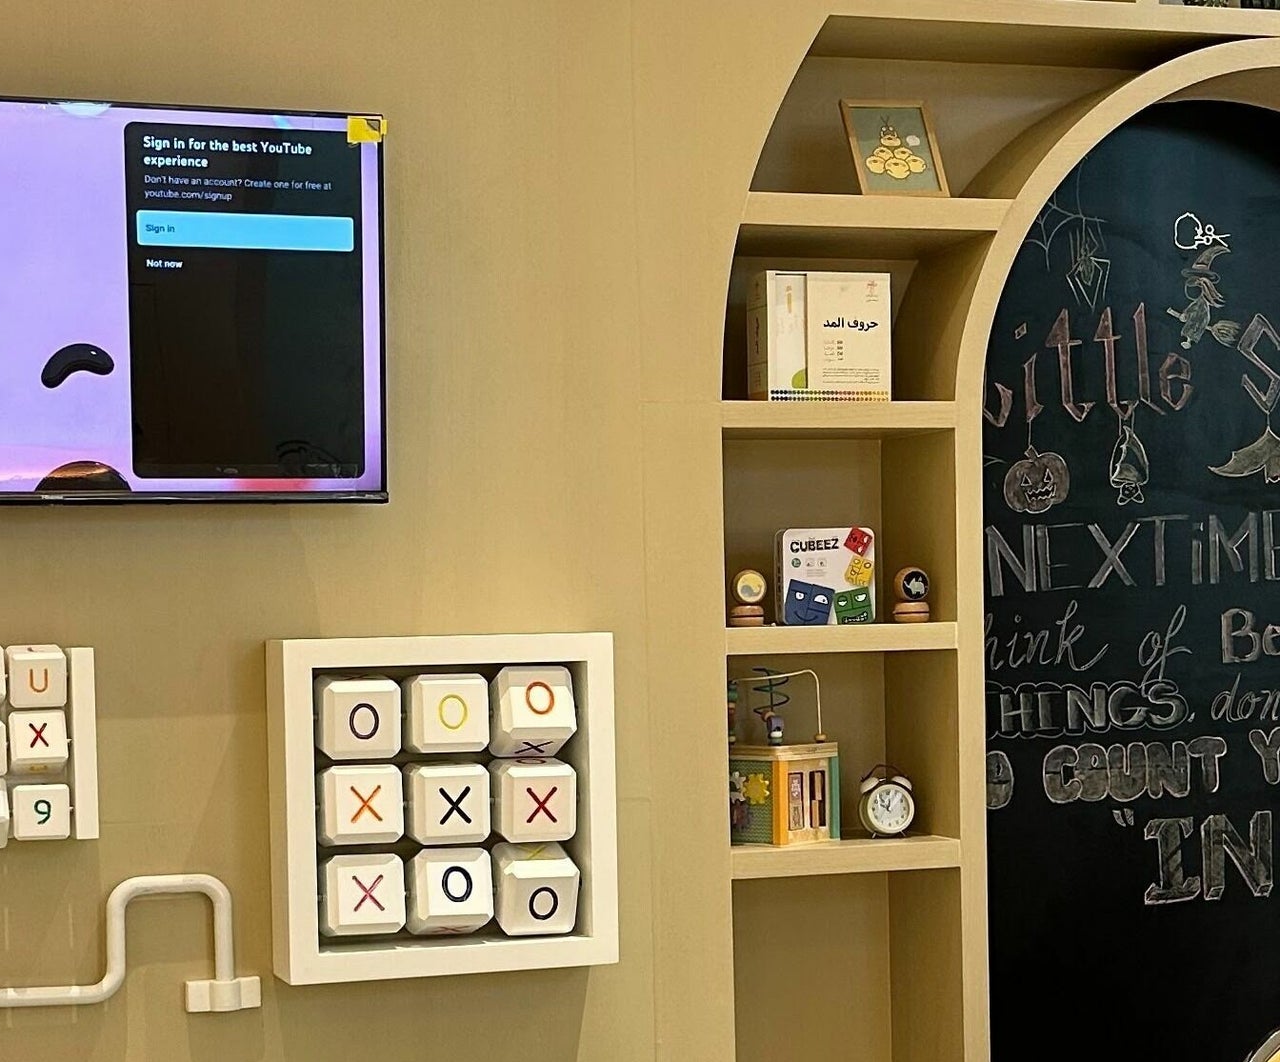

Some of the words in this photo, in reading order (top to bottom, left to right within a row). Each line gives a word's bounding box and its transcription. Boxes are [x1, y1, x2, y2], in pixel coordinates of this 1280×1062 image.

[143, 136, 170, 150] Sign
[173, 137, 186, 149] in
[188, 137, 206, 150] for
[209, 139, 229, 151] the
[232, 140, 258, 152] best
[260, 141, 312, 155] YouTube
[143, 155, 208, 168] experience
[144, 175, 167, 184] Don't
[168, 176, 189, 185] have
[191, 178, 202, 186] an
[204, 178, 242, 188] account?
[244, 179, 271, 188] Create
[273, 181, 289, 189] one
[291, 181, 303, 190] for
[305, 181, 321, 190] free
[323, 182, 332, 190] at
[144, 188, 232, 201] youtube.com/signup
[145, 223, 165, 234] Sign
[167, 223, 175, 233] in
[146, 258, 162, 268] Not
[164, 260, 183, 268] now
[823, 316, 845, 328] المد
[847, 317, 879, 332] حروف
[790, 538, 839, 553] CUBEEZ
[1138, 604, 1193, 690] of
[29, 668, 48, 693] U
[29, 722, 49, 748] X
[1042, 736, 1228, 804] COUNT
[33, 799, 52, 825] 9
